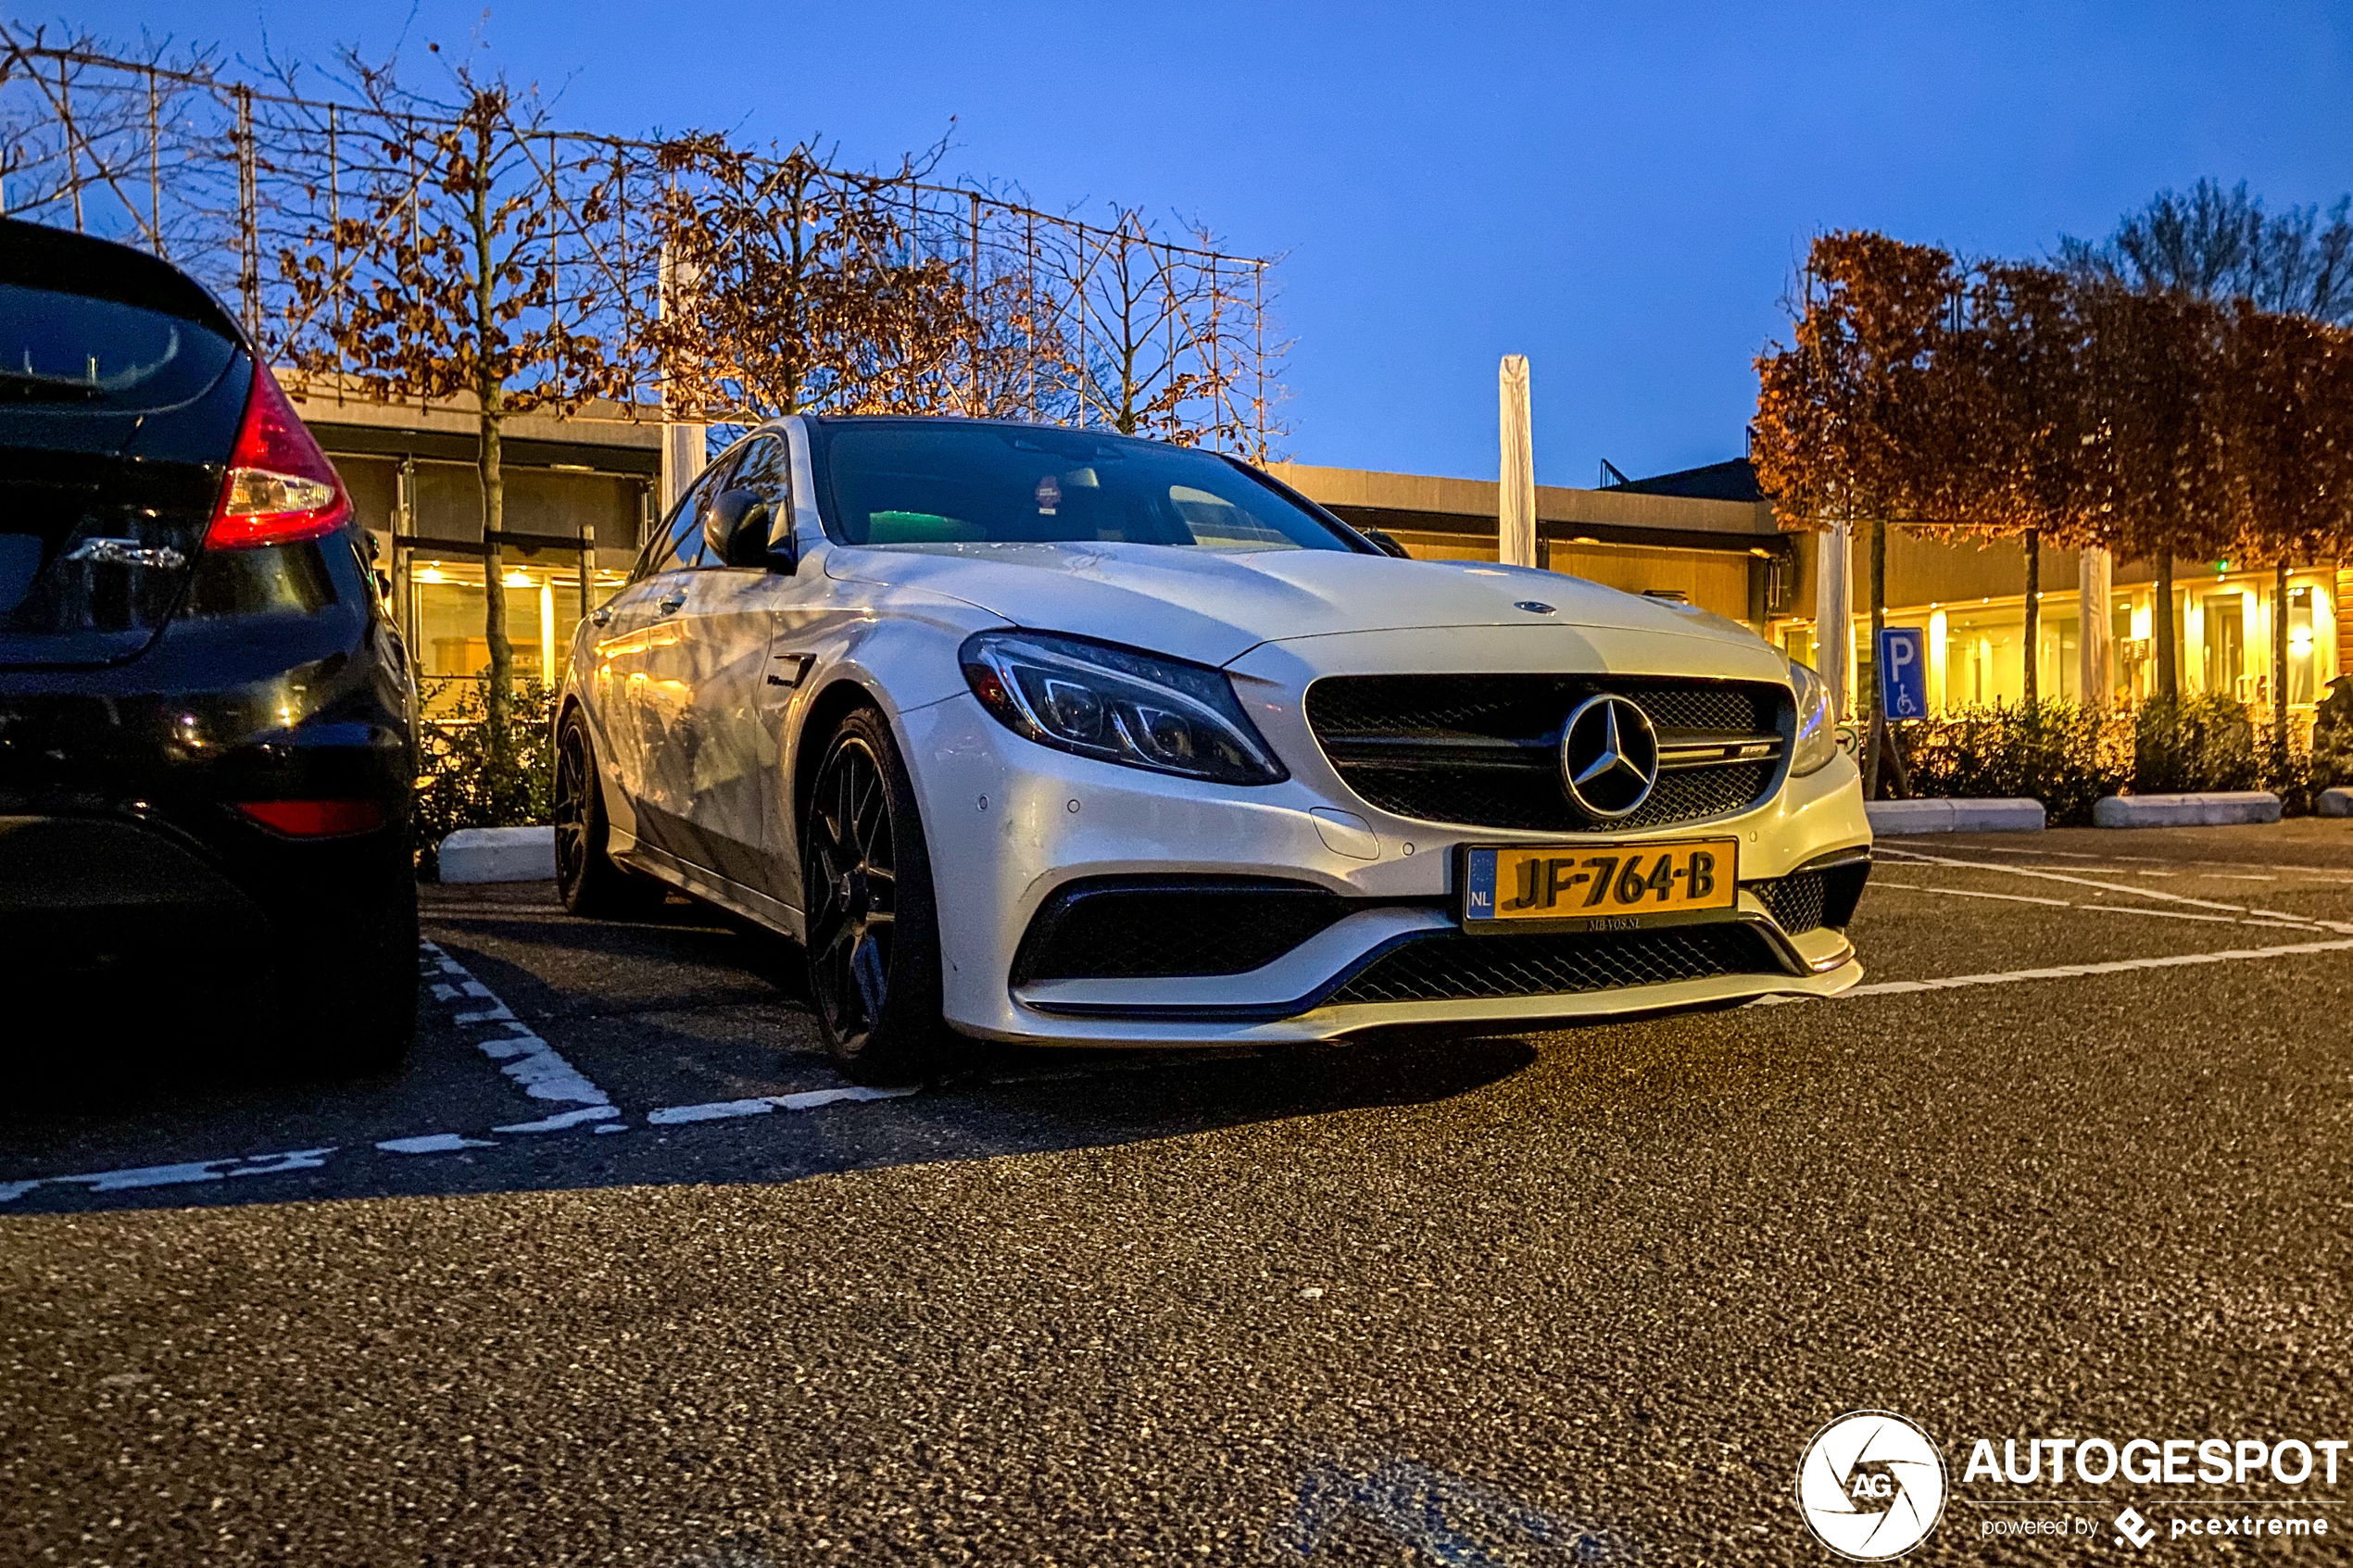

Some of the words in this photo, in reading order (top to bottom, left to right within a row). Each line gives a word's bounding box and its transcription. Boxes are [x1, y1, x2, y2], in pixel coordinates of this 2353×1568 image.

[1890, 636, 1914, 683] P
[1471, 891, 1491, 906] NL
[1502, 851, 1715, 910] JF-764-B
